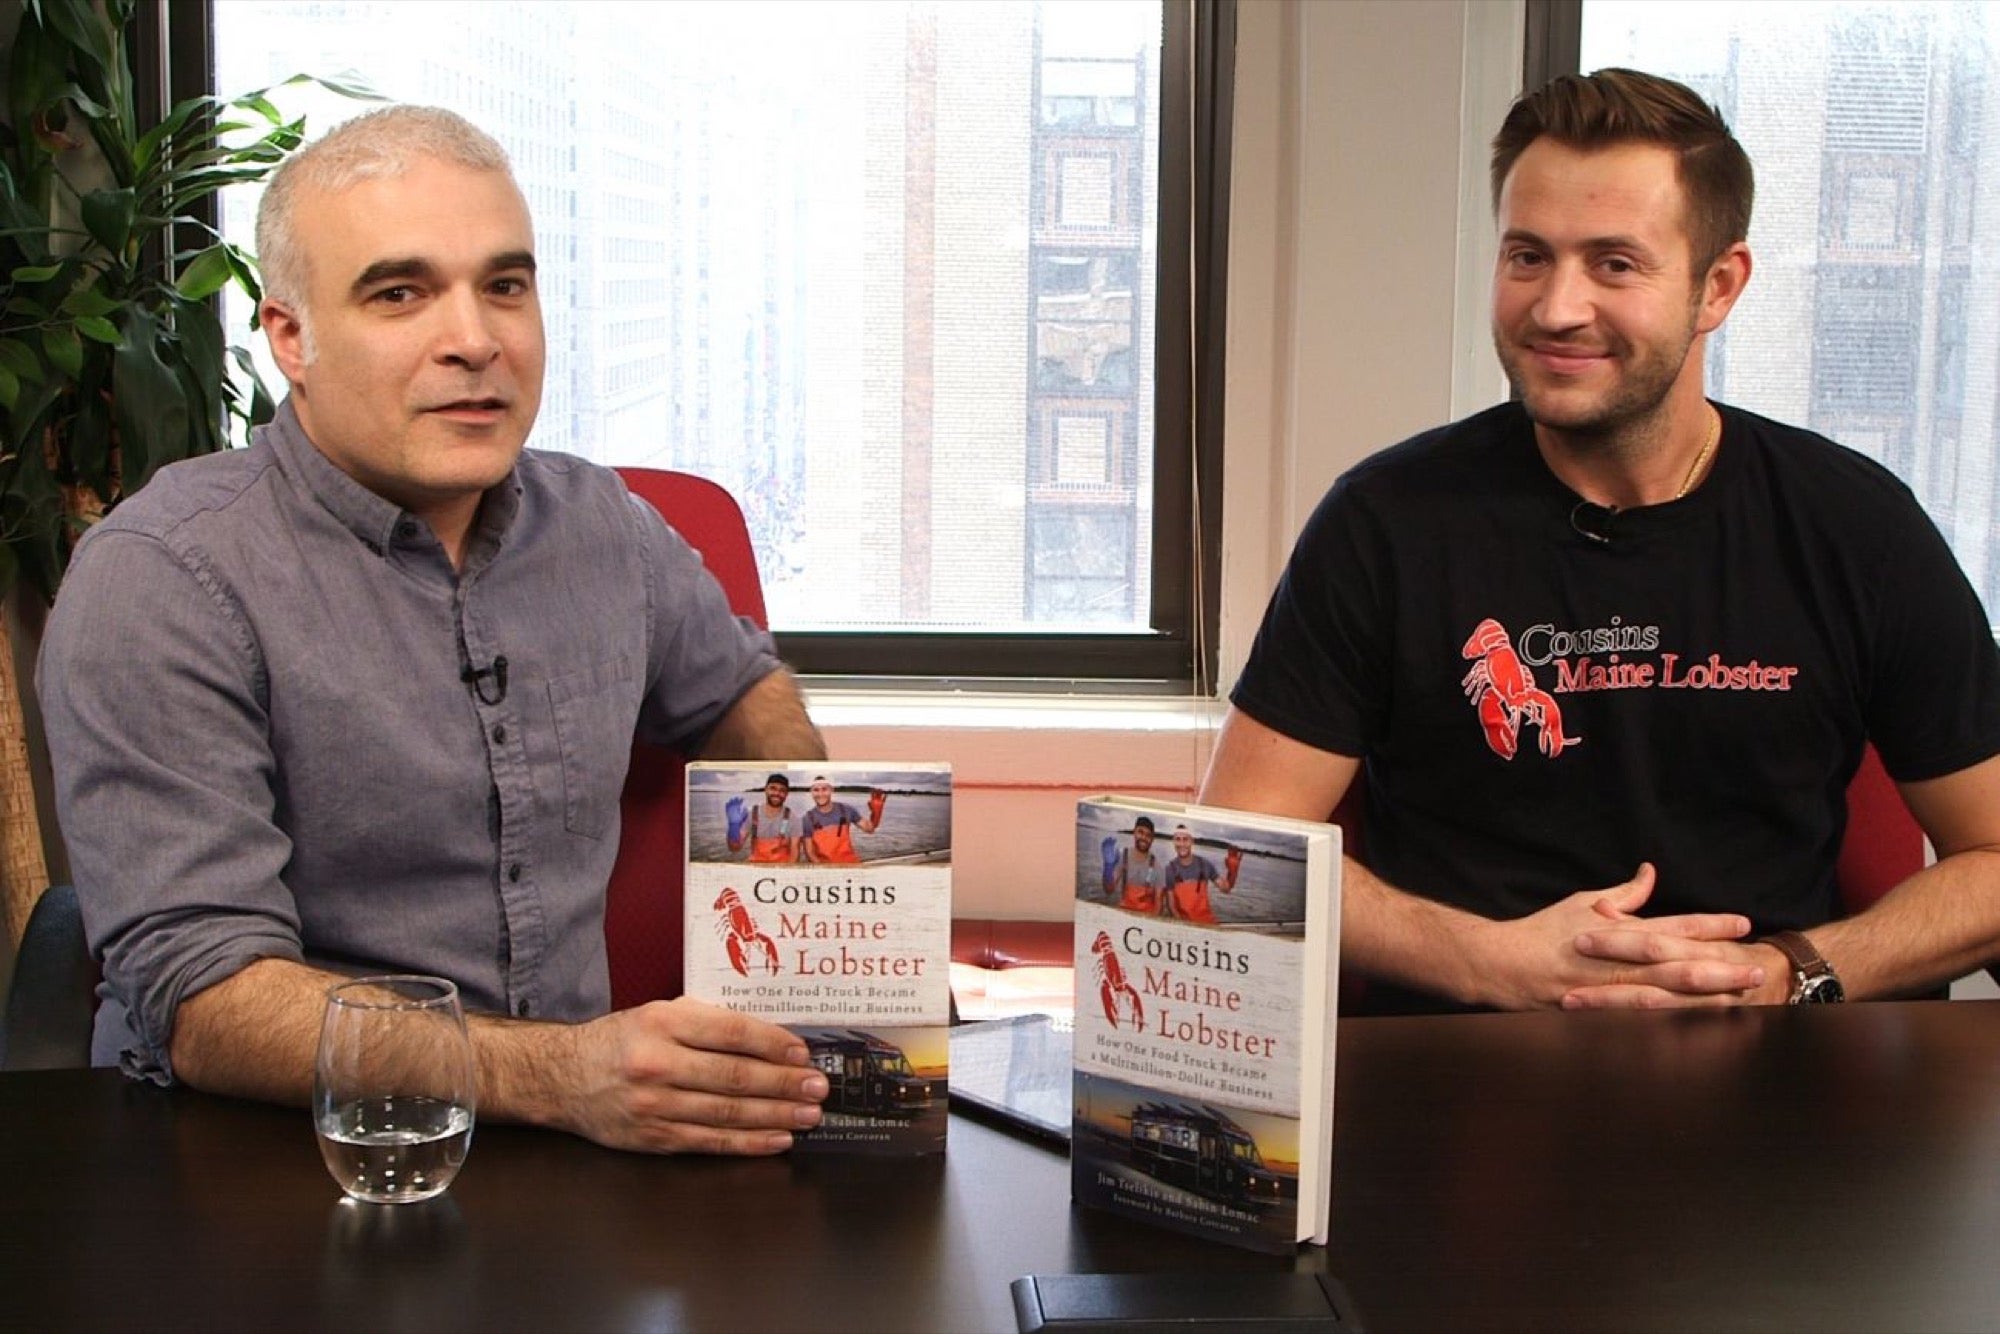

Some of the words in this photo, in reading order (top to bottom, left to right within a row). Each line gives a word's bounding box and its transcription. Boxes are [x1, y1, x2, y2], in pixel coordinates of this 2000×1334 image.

[1519, 616, 1660, 667] Cousins
[1553, 654, 1655, 693] Maine
[1660, 653, 1798, 691] Lobster
[753, 877, 897, 905] Cousins
[776, 912, 888, 940] Maine
[794, 945, 926, 977] Lobster
[1122, 926, 1250, 975] Cousins
[721, 985, 750, 997] How
[756, 985, 782, 997] One
[788, 985, 820, 997] Food
[825, 986, 862, 998] Truck
[867, 986, 917, 998] Became
[866, 1002, 924, 1014] Business
[1142, 965, 1242, 1012] Maine
[1156, 1008, 1277, 1059] Lobster
[1096, 1033, 1121, 1049] How
[1124, 1040, 1147, 1056] One
[1151, 1046, 1179, 1063] Food
[1183, 1053, 1217, 1071] Truck
[1221, 1061, 1268, 1082] Became
[1101, 1051, 1216, 1088] Multimillion-Dollar
[1219, 1079, 1274, 1099] Business
[869, 1116, 911, 1128] Lomac
